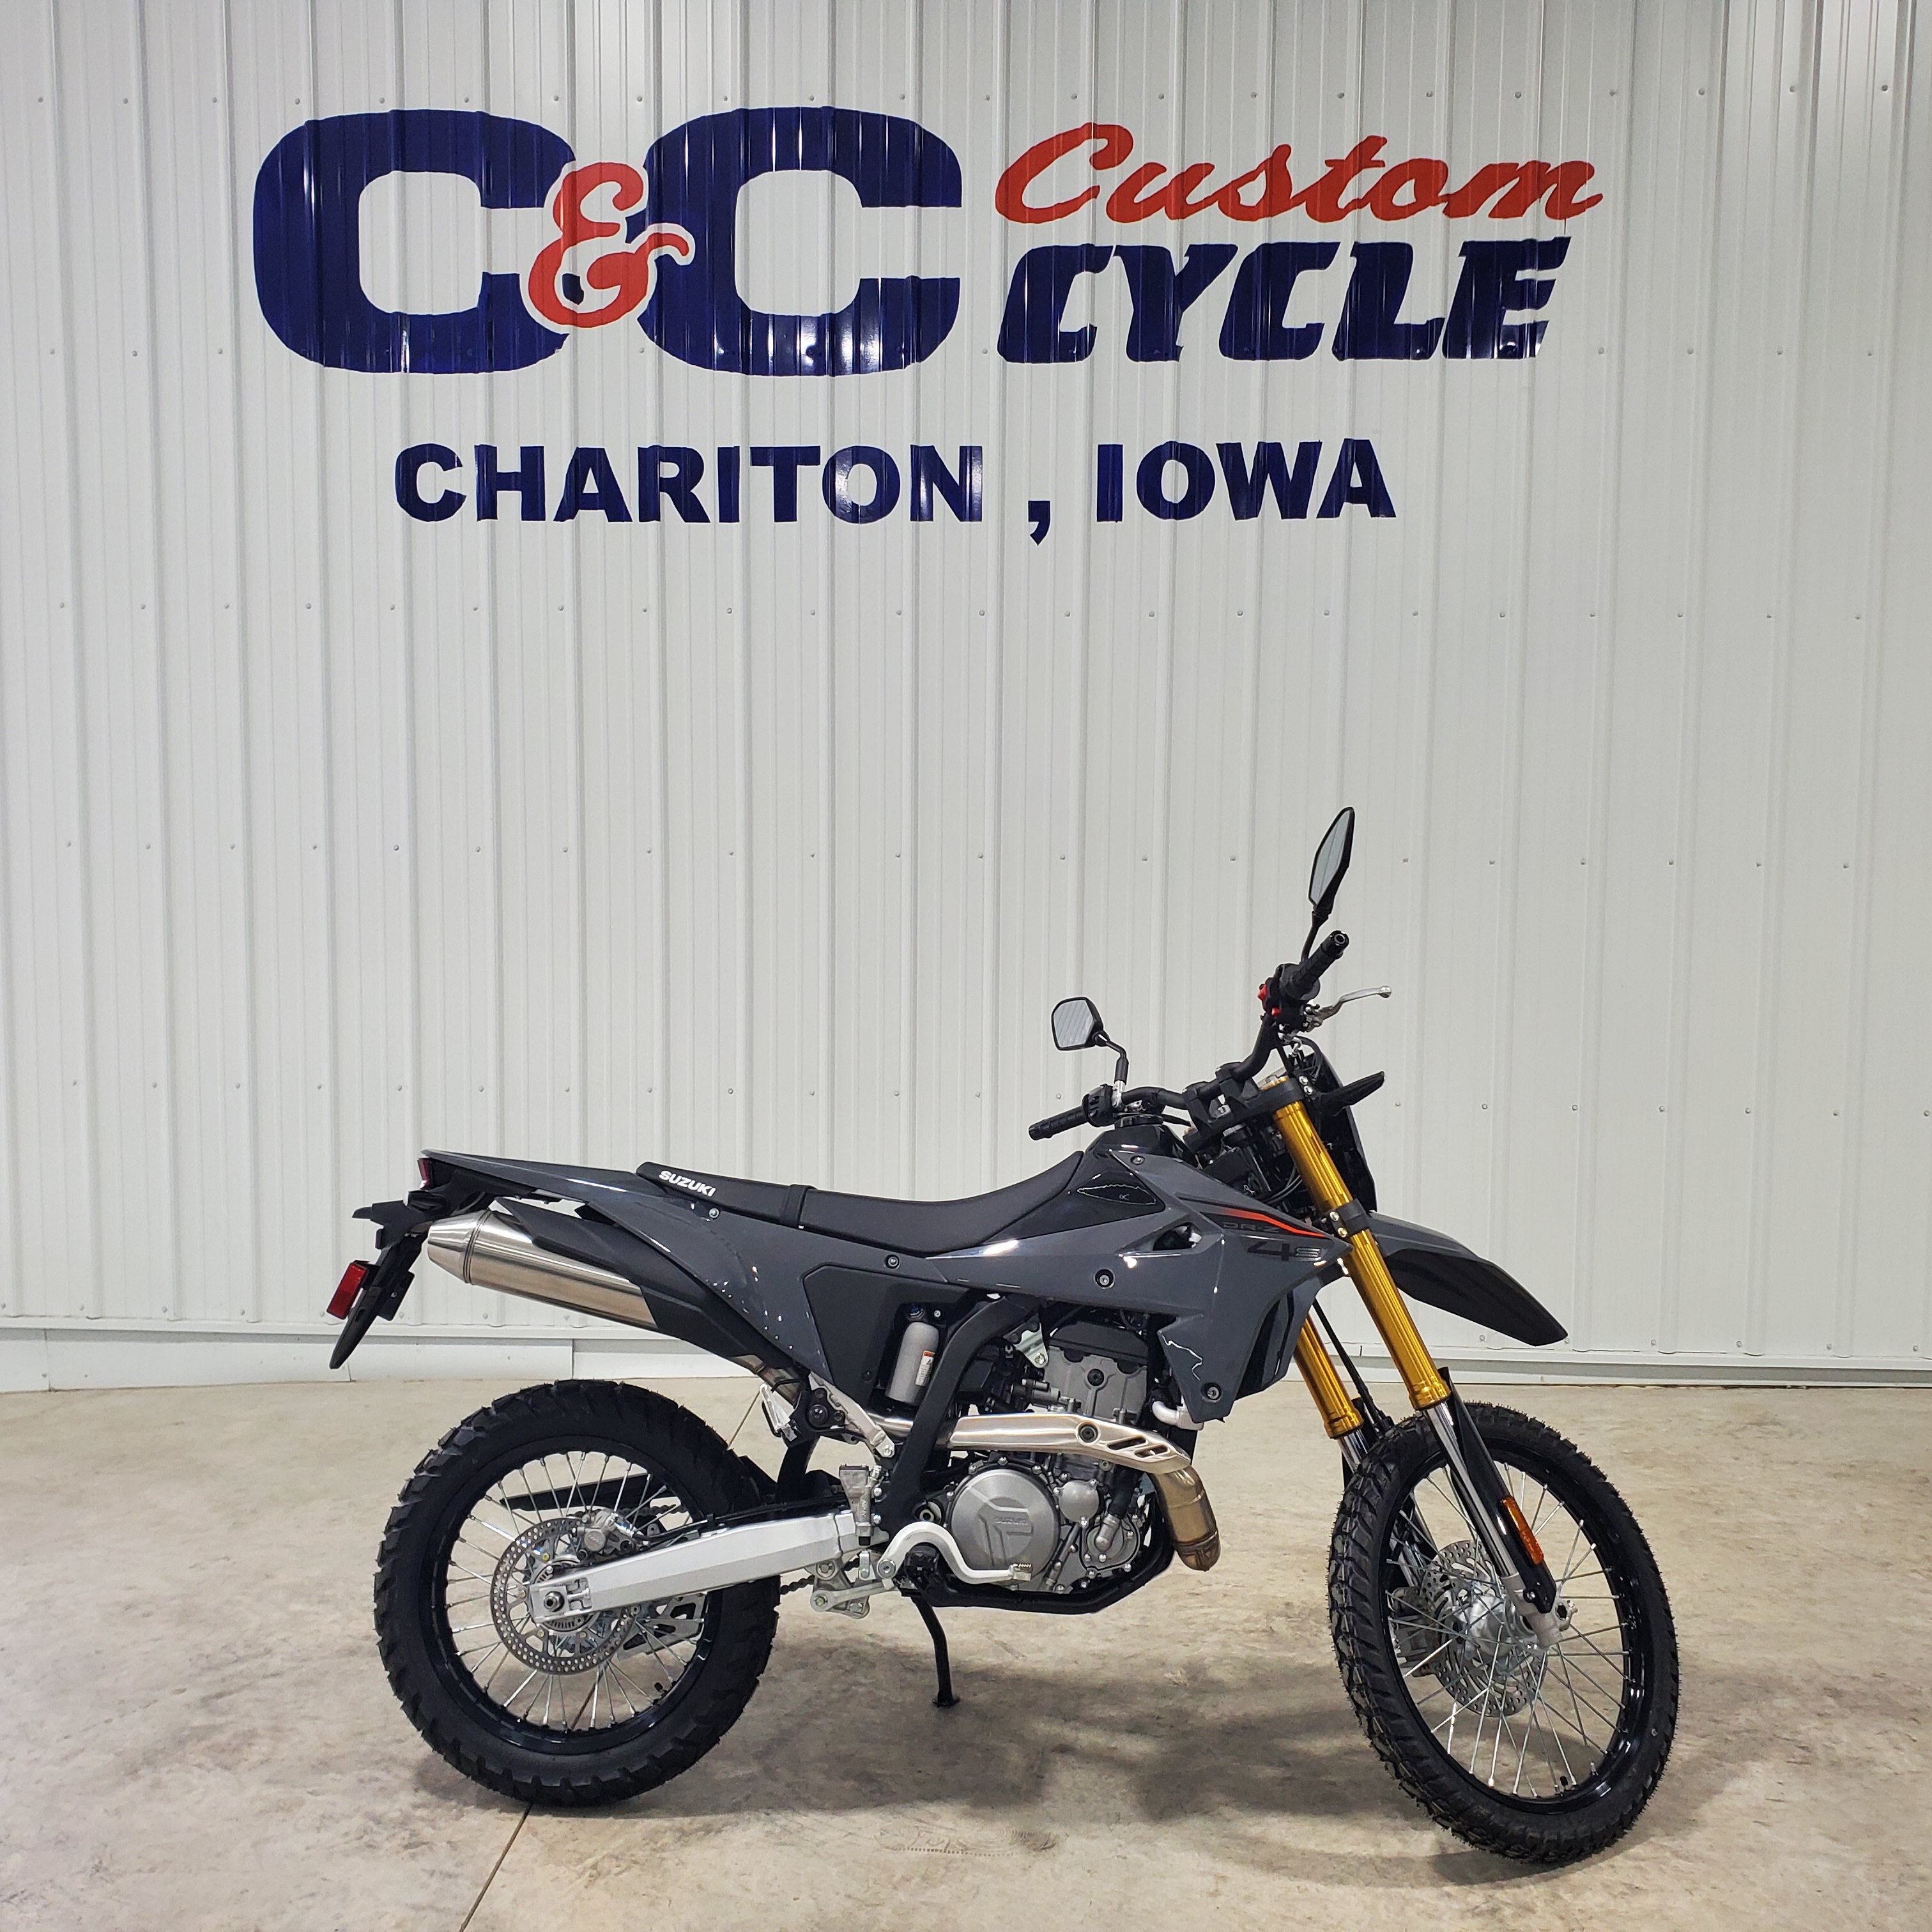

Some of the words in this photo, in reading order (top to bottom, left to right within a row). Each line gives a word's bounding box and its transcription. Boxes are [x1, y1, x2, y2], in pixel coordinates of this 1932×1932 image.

[995, 123, 1603, 224] Custom
[252, 106, 962, 376] C&C
[997, 236, 1571, 362] CYCLE
[394, 443, 983, 523] CHARITON
[1096, 438, 1395, 522] IOWA
[659, 1170, 716, 1197] SUZUKI
